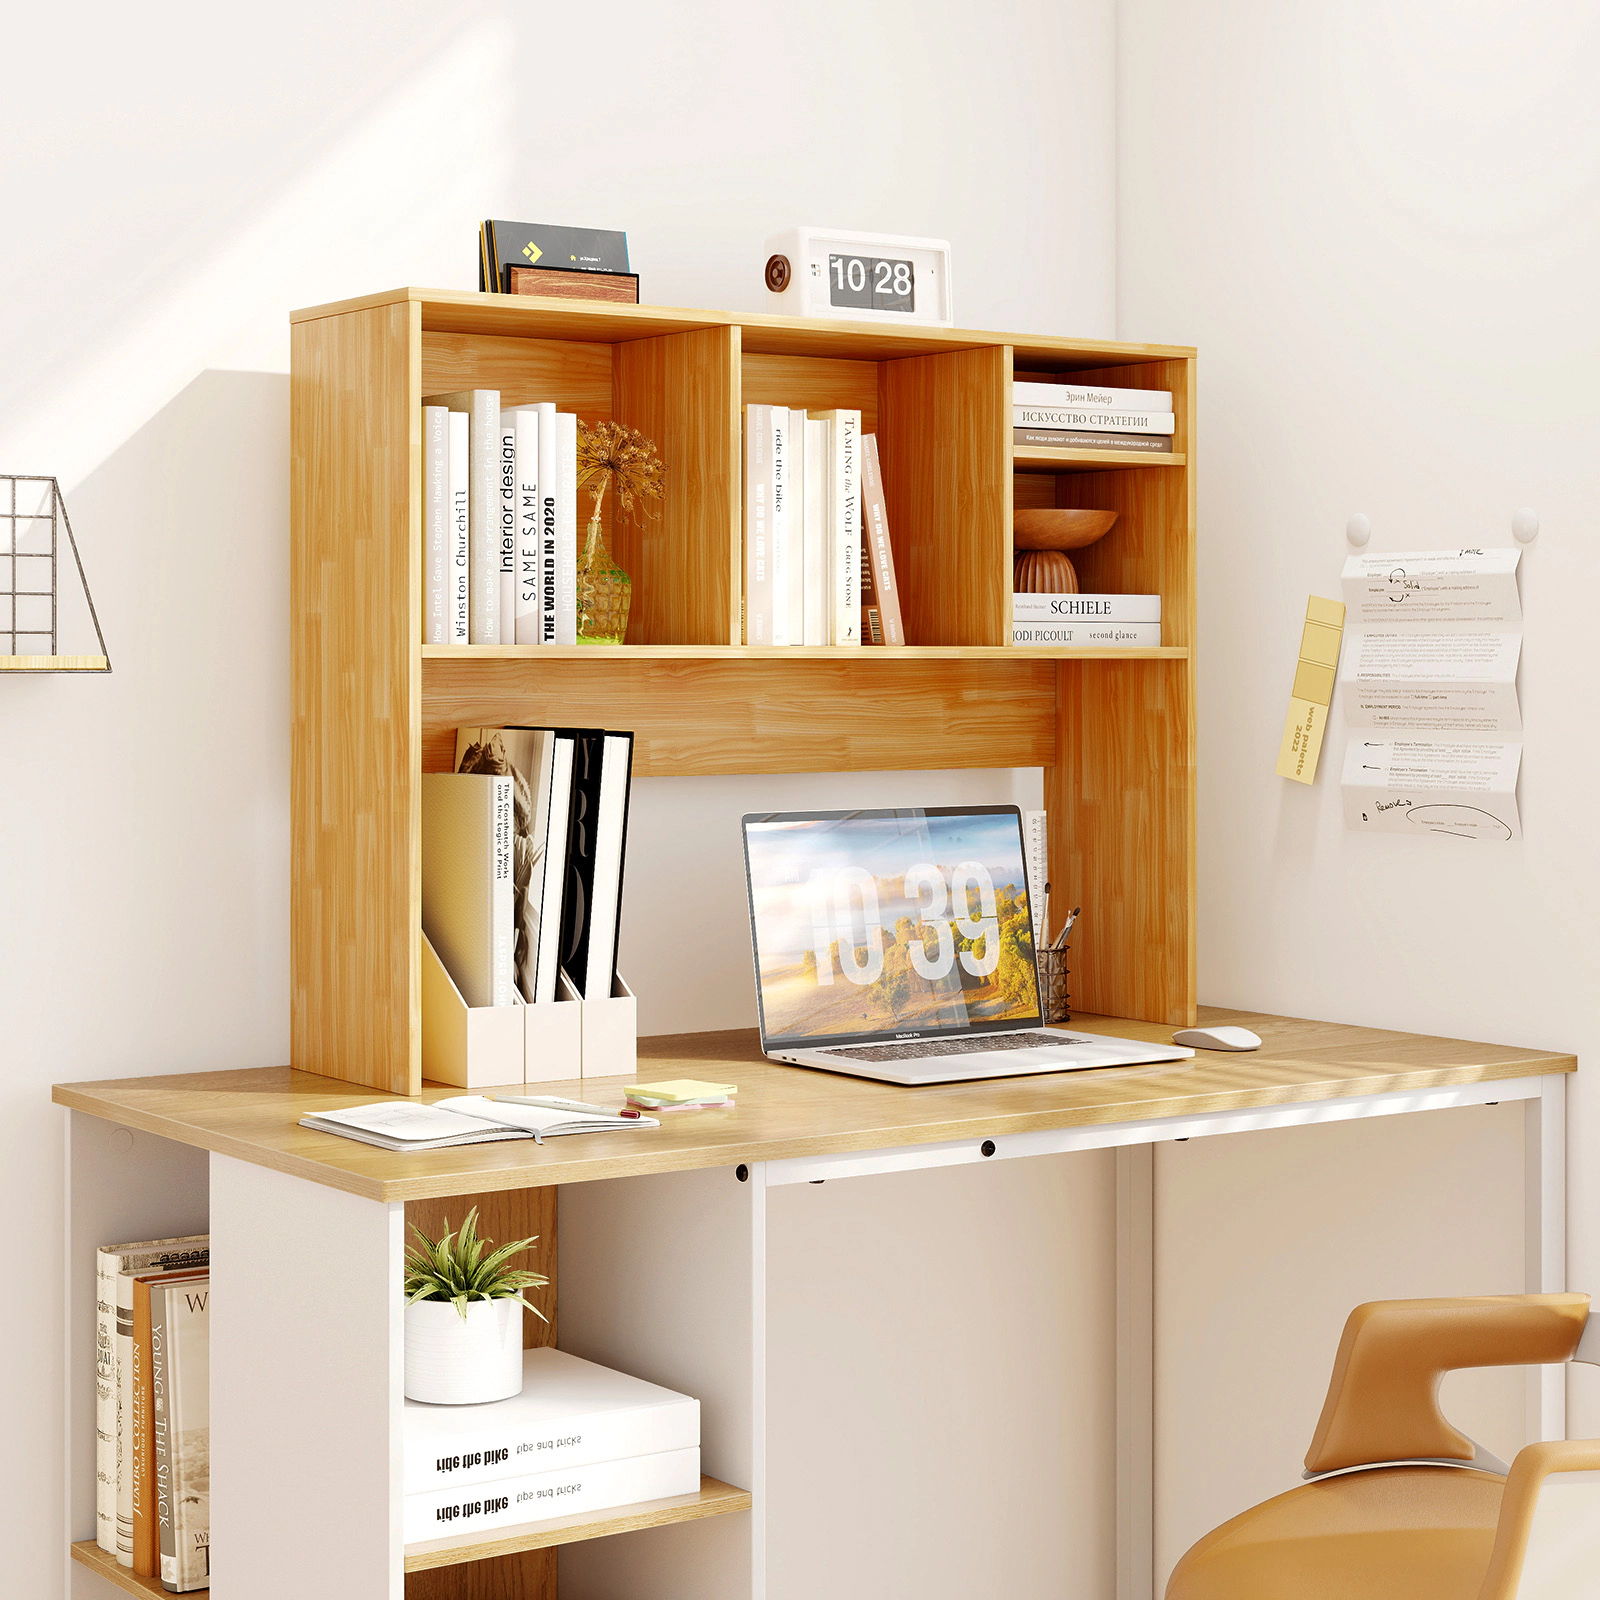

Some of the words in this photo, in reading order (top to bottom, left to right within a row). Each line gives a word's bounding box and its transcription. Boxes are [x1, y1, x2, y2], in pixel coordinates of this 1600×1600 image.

[831, 258, 866, 292] 10
[874, 261, 912, 296] 28
[484, 395, 494, 427] house
[1065, 391, 1085, 403] Эрин
[1086, 393, 1113, 406] Мейер
[433, 411, 442, 442] Voice
[1022, 411, 1087, 424] ИСКУССТВО
[1089, 414, 1148, 427] СТРАТЕГИИ
[484, 432, 493, 451] the
[844, 417, 855, 474] TAMING
[484, 457, 493, 469] in
[500, 435, 516, 499] design
[433, 460, 444, 502] Hawking
[756, 483, 765, 504] WHY
[844, 478, 852, 493] the
[486, 476, 496, 543] arrangement
[522, 483, 536, 536] SAME
[544, 497, 555, 536] 2020
[844, 496, 855, 536] WOLF
[872, 503, 882, 522] WHY
[433, 511, 444, 551] Stephen
[455, 490, 466, 567] Churchill
[500, 505, 514, 573] Interior
[875, 523, 883, 535] DO
[877, 535, 886, 549] WE
[486, 550, 493, 562] an
[544, 539, 555, 555] IN
[756, 535, 765, 558] LOVE
[845, 545, 853, 574] GREG
[879, 550, 888, 570] LOVE
[433, 558, 442, 582] Gave
[484, 569, 493, 594] make
[522, 549, 536, 601] SAME
[544, 558, 555, 611] WORLD
[882, 570, 892, 591] CATS
[433, 588, 442, 617] Intel
[455, 575, 466, 637] Winston
[486, 600, 493, 612] to
[845, 576, 853, 609] STONE
[1050, 600, 1112, 615] SCHIELE
[433, 625, 442, 642] How
[484, 619, 493, 638] How
[544, 614, 555, 641] THE
[1013, 630, 1032, 642] JODI
[1035, 630, 1074, 642] PICOULT
[1089, 630, 1113, 640] second
[1115, 630, 1138, 641] glance
[1305, 706, 1315, 732] web
[1291, 724, 1302, 753] 2022
[1295, 734, 1309, 776] palette
[497, 848, 503, 857] of
[791, 865, 884, 987] 10
[904, 861, 1000, 981] 39
[152, 1324, 164, 1395] YOUNG
[155, 1417, 167, 1457] THE
[133, 1456, 143, 1518] JUMBO
[157, 1462, 170, 1529] SHACK
